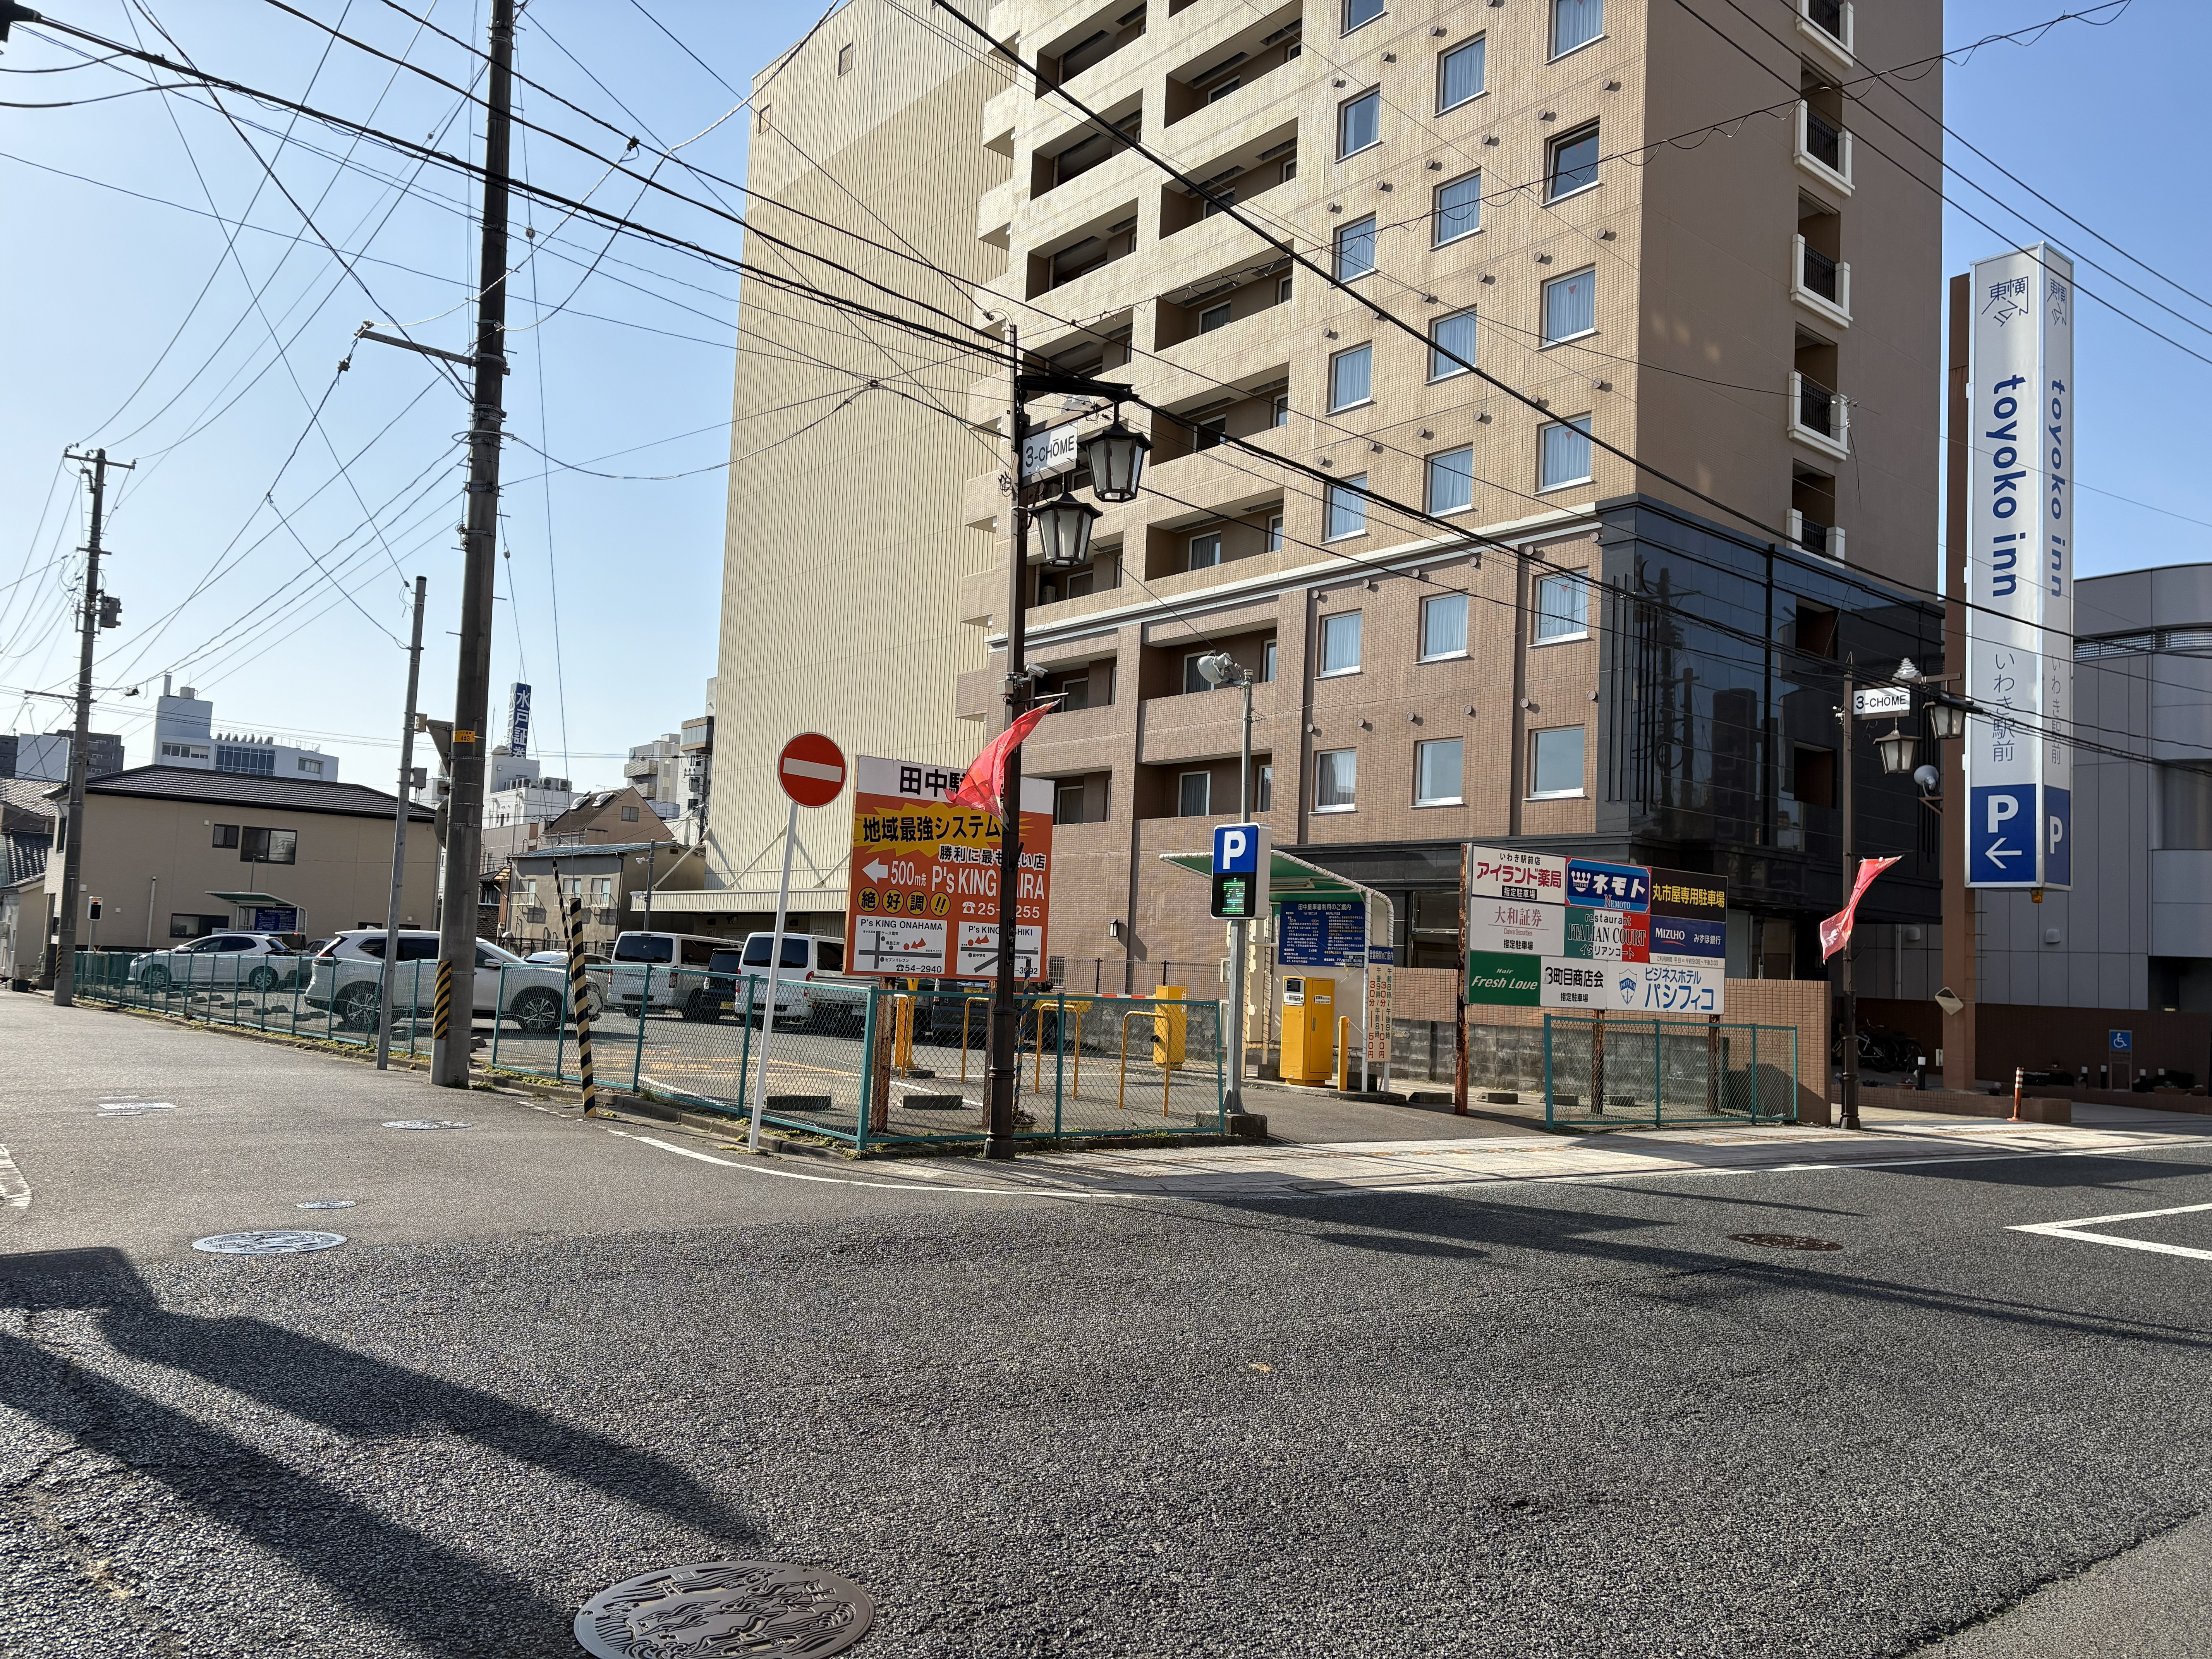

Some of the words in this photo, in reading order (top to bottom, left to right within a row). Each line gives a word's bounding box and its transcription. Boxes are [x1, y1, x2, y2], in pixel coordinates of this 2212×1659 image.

[1985, 374, 2027, 519] toyoko
[2049, 379, 2066, 520] toyoko
[1993, 531, 2026, 598] inn
[2051, 535, 2066, 598] inn
[1992, 653, 2015, 763] いわき駅前
[1988, 795, 2018, 833] P
[863, 815, 1001, 843] 地域最強システム
[2050, 815, 2063, 854] P
[1223, 831, 1246, 869] P
[1500, 852, 1540, 866] いわき駅前店
[891, 860, 926, 886] 500m先
[932, 866, 954, 893] P's
[958, 868, 996, 897] KING
[1477, 862, 1561, 888] アイランド薬局
[1504, 886, 1535, 899] 指定駐車場
[1592, 874, 1645, 898] ネモト
[1652, 883, 1725, 908] 丸市屋専用駐車場
[1604, 894, 1630, 909] NEMOTO
[861, 919, 873, 927] P's
[876, 919, 896, 928] KING
[900, 921, 943, 931] ONAHAMA
[1494, 905, 1542, 927] 大和証券
[1585, 914, 1631, 926] restaurant
[1503, 939, 1533, 950] 指定駐車場
[1568, 923, 1609, 943] ITALIAN
[1613, 927, 1646, 946] COURT
[1655, 927, 1685, 940] MIZUHO
[1693, 934, 1721, 945] みずほ銀行
[1580, 944, 1635, 959] イタリアンコート
[905, 964, 942, 973] 54-2940
[1645, 967, 1701, 984] ビジネスホテル
[1471, 975, 1507, 988] Fresh
[1509, 978, 1538, 990] Love
[1560, 992, 1589, 1002] 指定駐車場
[1645, 983, 1714, 1010] パシフィコ
